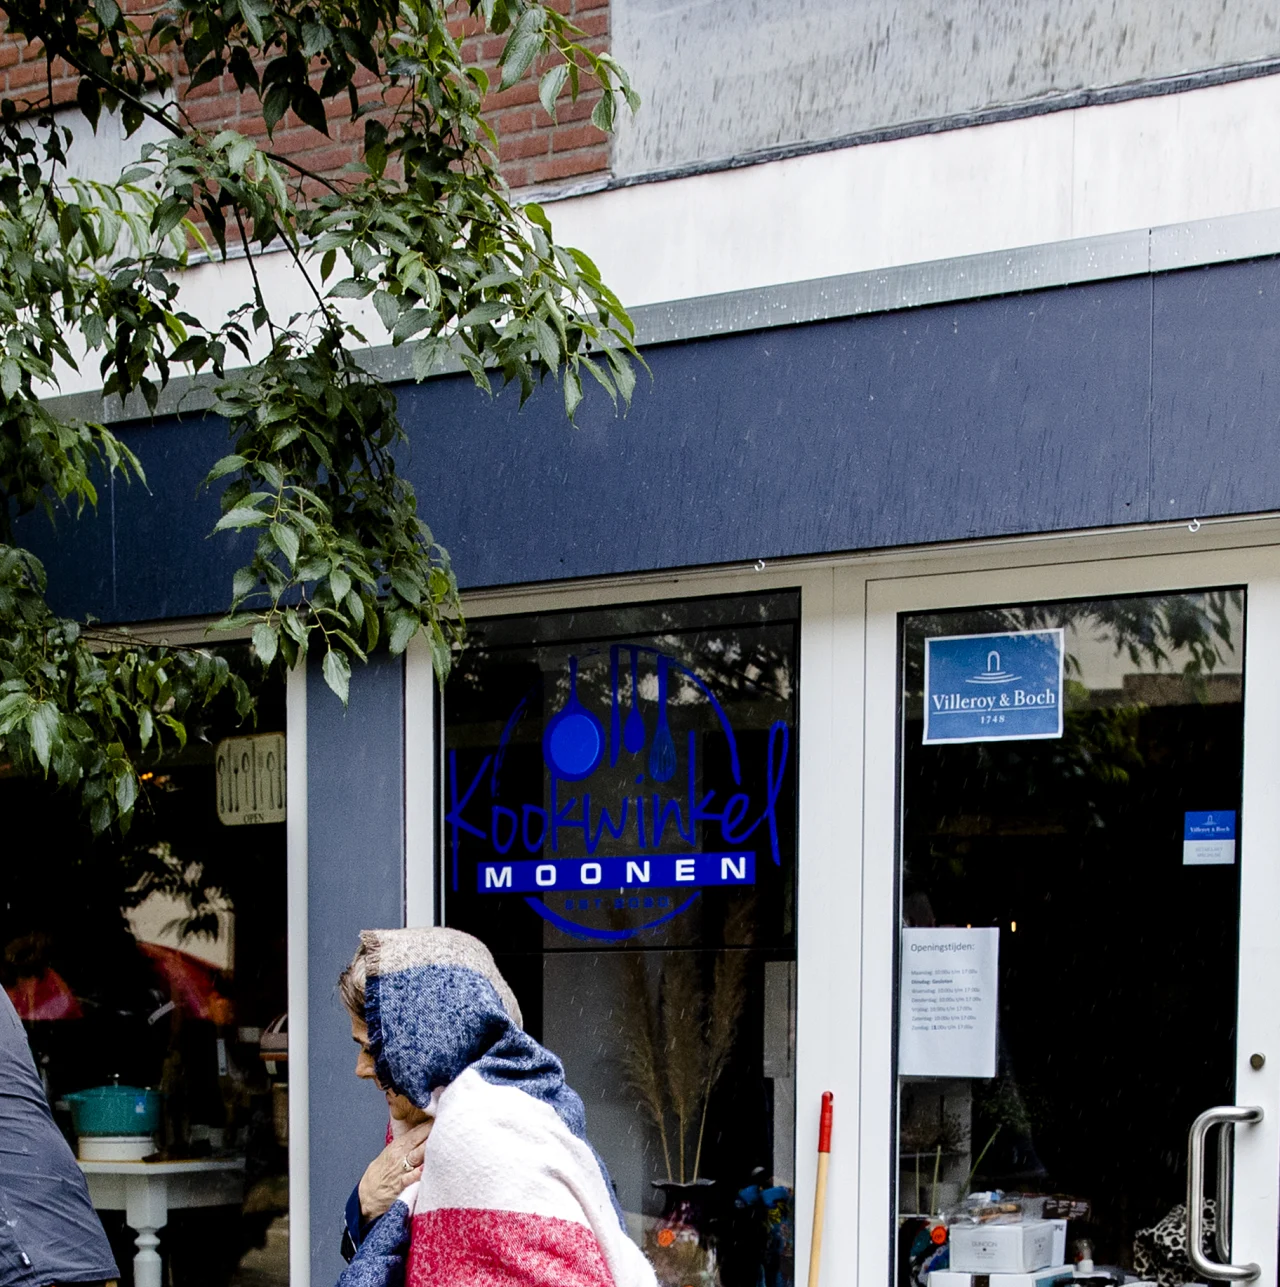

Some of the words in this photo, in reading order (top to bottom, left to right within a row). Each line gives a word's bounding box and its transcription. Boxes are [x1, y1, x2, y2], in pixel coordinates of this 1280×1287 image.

[932, 693, 996, 711] Villeroy
[999, 693, 1011, 707] &
[1014, 688, 1056, 706] Boch
[980, 714, 1005, 724] 1748
[445, 720, 790, 892] Kookwinkel
[243, 813, 264, 824] OPEN
[484, 856, 747, 889] MOONEN
[565, 898, 602, 910] EST
[911, 943, 975, 953] Openingstijden:
